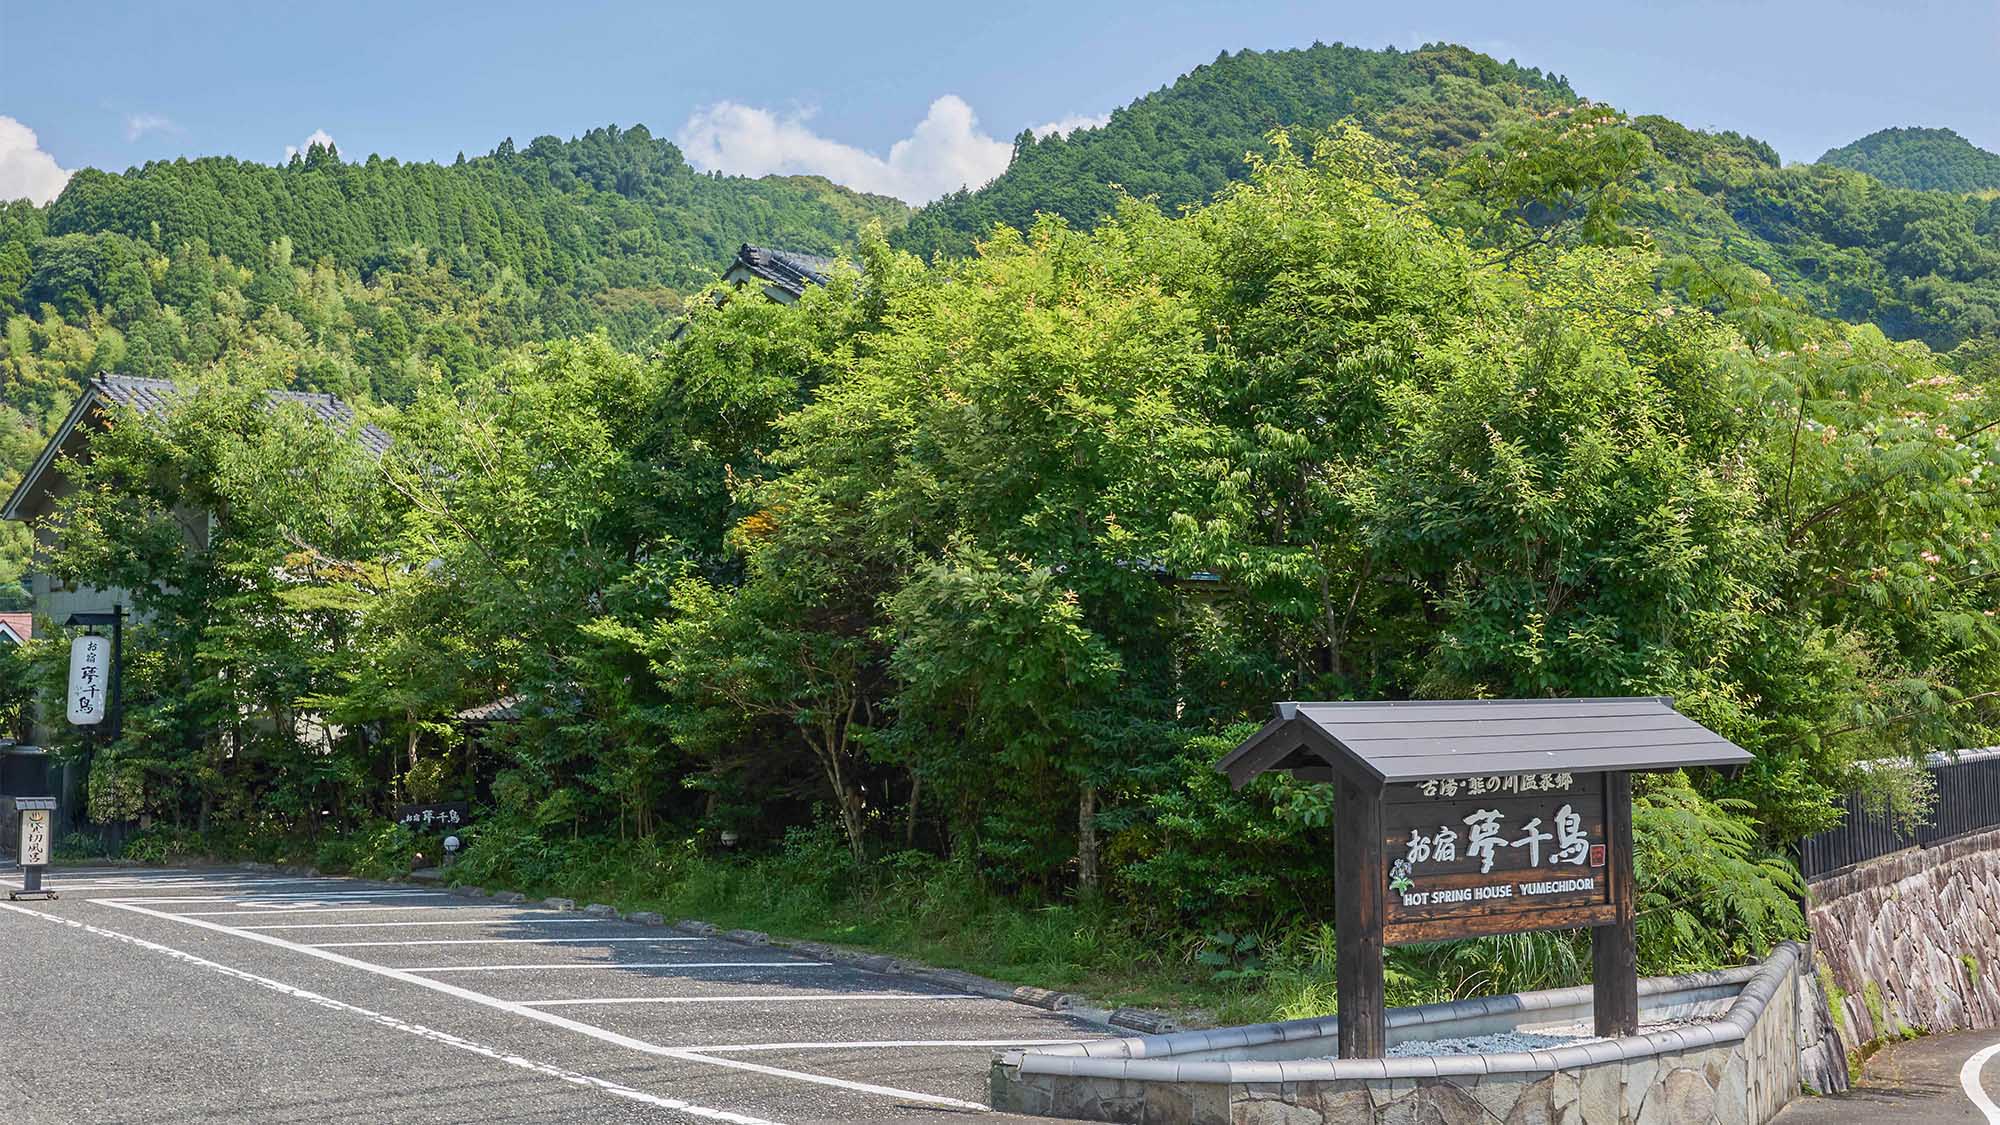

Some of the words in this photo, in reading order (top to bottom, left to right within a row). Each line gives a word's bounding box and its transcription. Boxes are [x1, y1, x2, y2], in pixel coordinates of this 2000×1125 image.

[1403, 892, 1430, 906] HOT
[1431, 888, 1472, 904] SPRING
[1474, 885, 1512, 900] HOUSE
[1519, 878, 1594, 896] YUMECHIDORI
